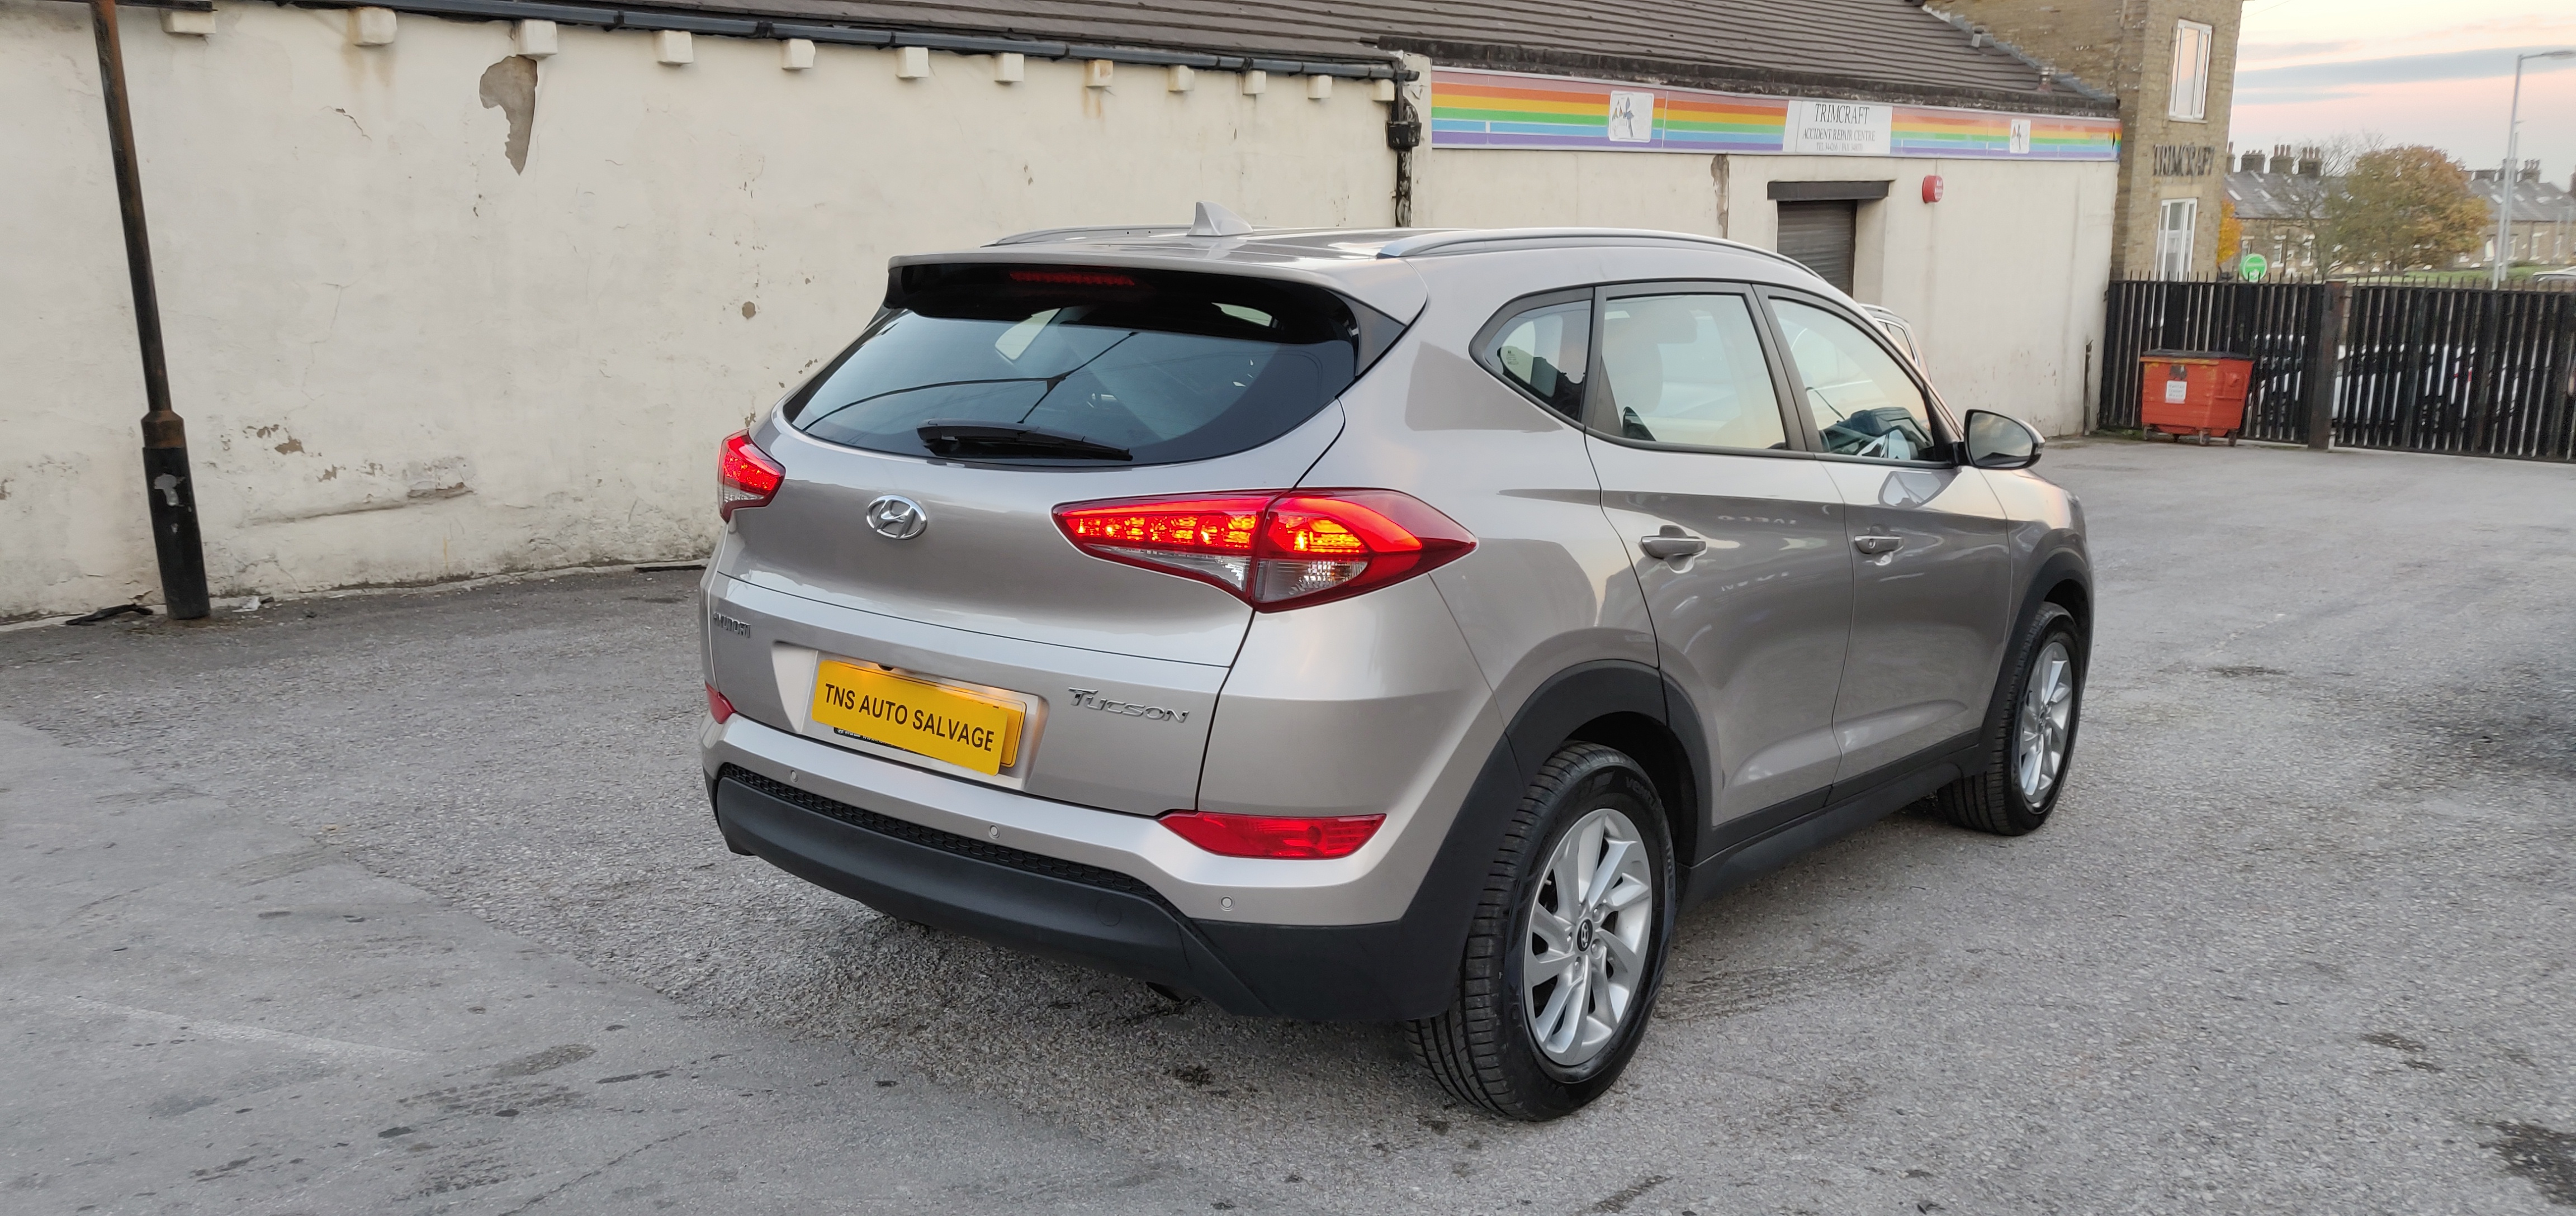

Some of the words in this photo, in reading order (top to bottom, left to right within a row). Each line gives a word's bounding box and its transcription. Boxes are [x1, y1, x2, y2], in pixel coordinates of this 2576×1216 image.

[1815, 103, 1869, 124] TRIMCRAFT
[1802, 127, 1832, 140] ACCIDENT
[1833, 129, 1852, 141] REPAIR
[1854, 130, 1876, 141] CENTRE
[825, 683, 855, 710] TNS
[859, 695, 907, 724] AUTO
[912, 709, 995, 752] SALVAGE
[1068, 687, 1190, 723] TUCSON
